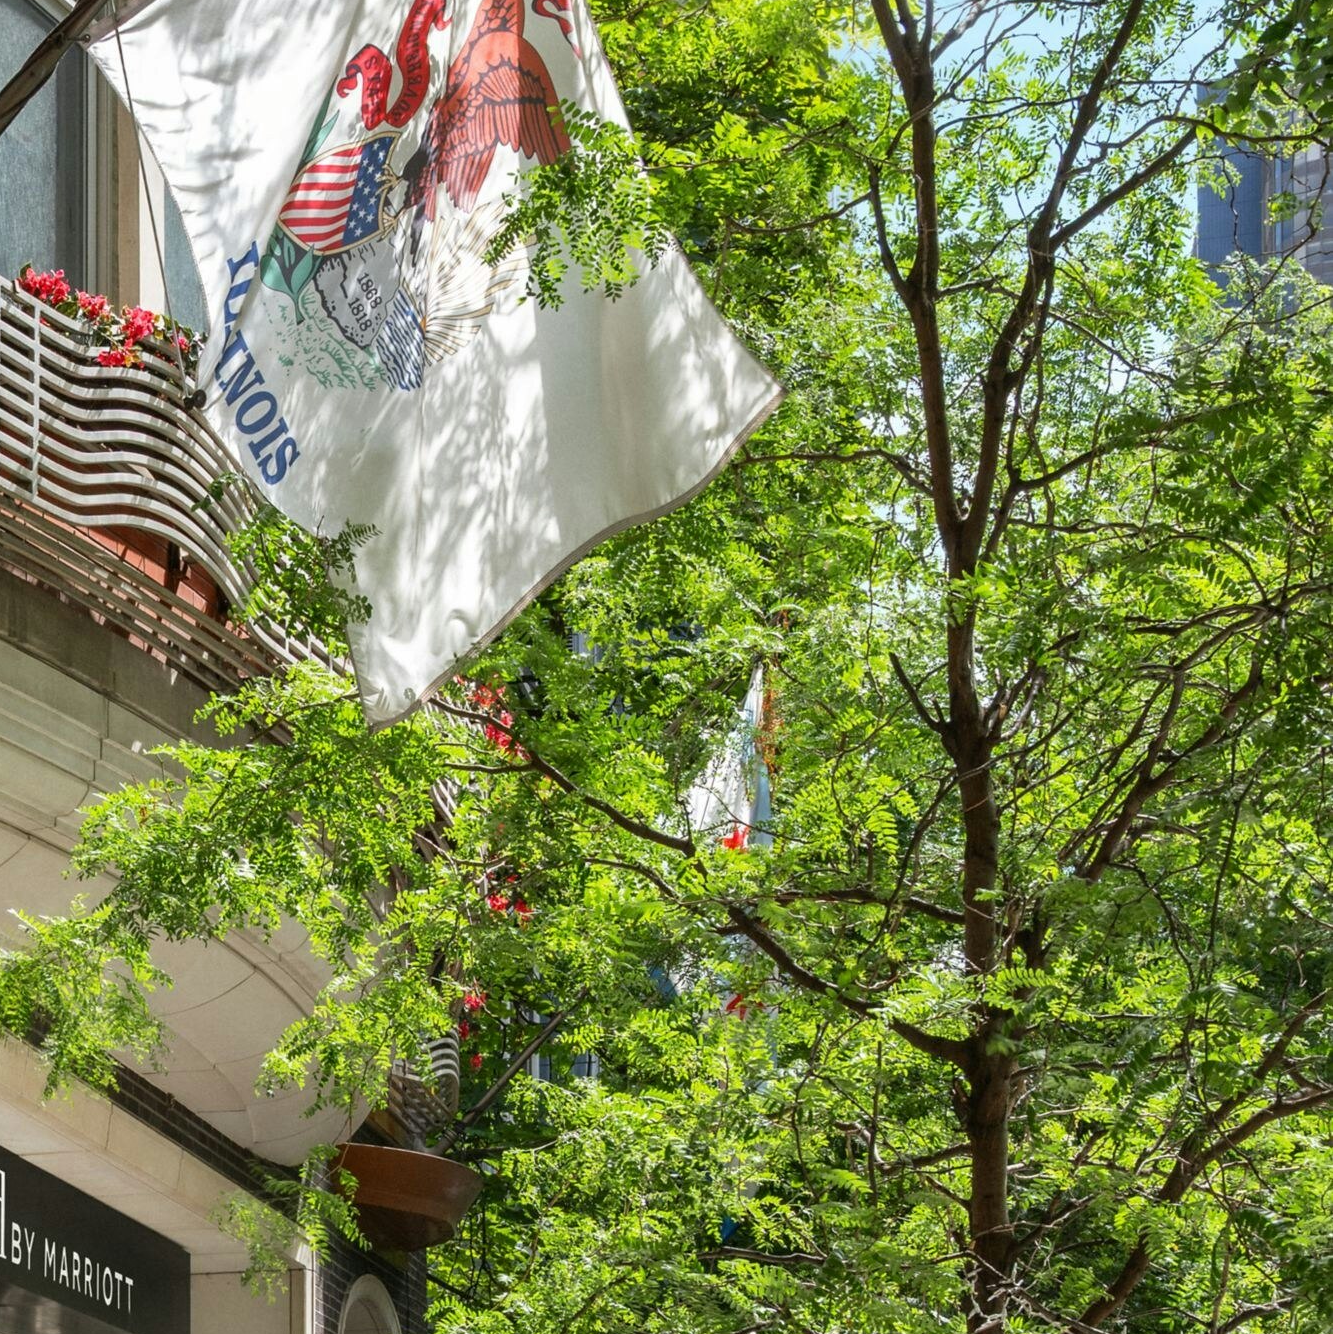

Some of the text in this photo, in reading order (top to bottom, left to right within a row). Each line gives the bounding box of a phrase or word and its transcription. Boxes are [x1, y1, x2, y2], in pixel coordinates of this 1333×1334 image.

[357, 272, 382, 309] 1868
[348, 297, 372, 332] 1818
[11, 1221, 35, 1271] BY
[44, 1236, 134, 1314] MARRIOTT
